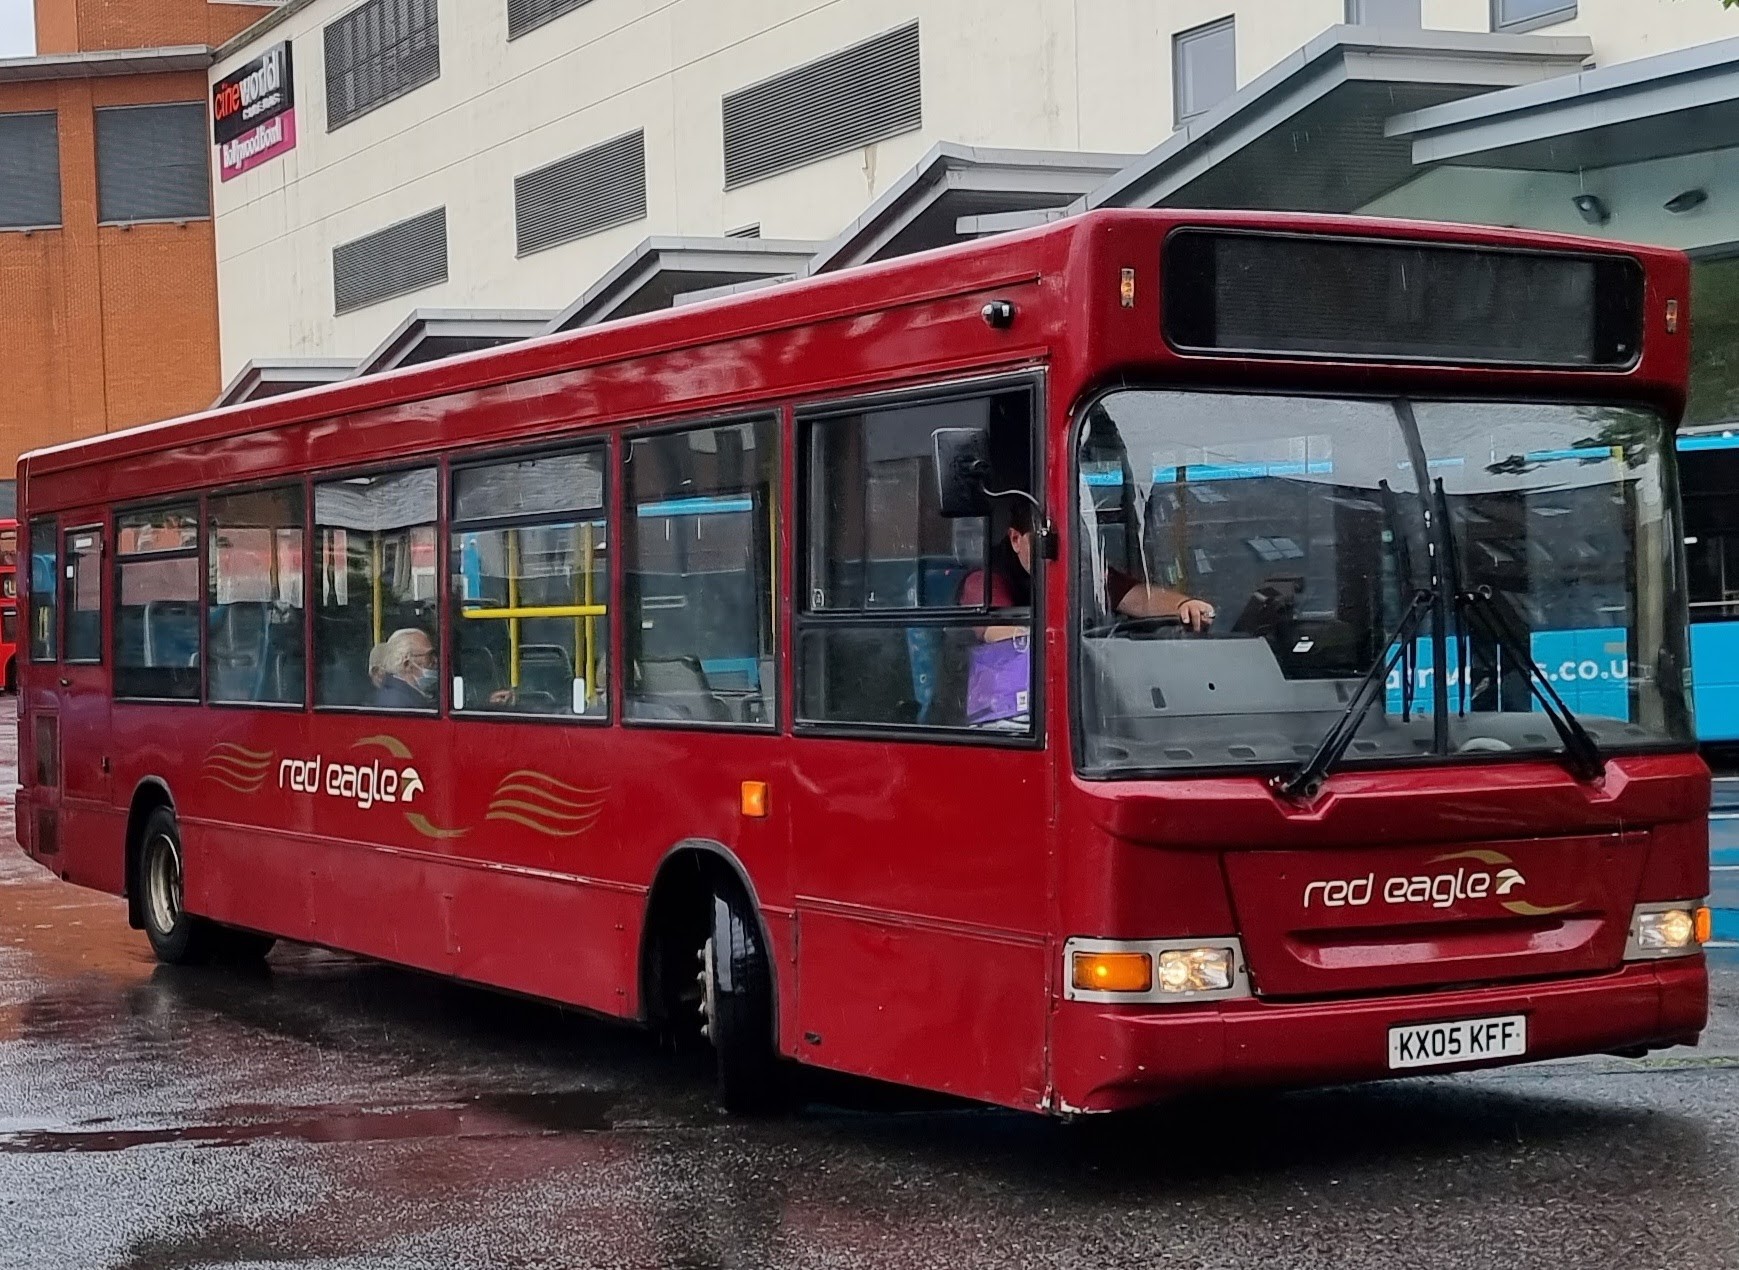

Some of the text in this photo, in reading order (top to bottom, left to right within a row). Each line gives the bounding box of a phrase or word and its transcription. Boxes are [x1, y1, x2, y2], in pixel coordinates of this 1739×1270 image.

[214, 50, 281, 120] cineworld
[278, 754, 399, 810] red eagle
[1303, 867, 1491, 908] red eagle
[1399, 1021, 1516, 1062] KX05 KFF
